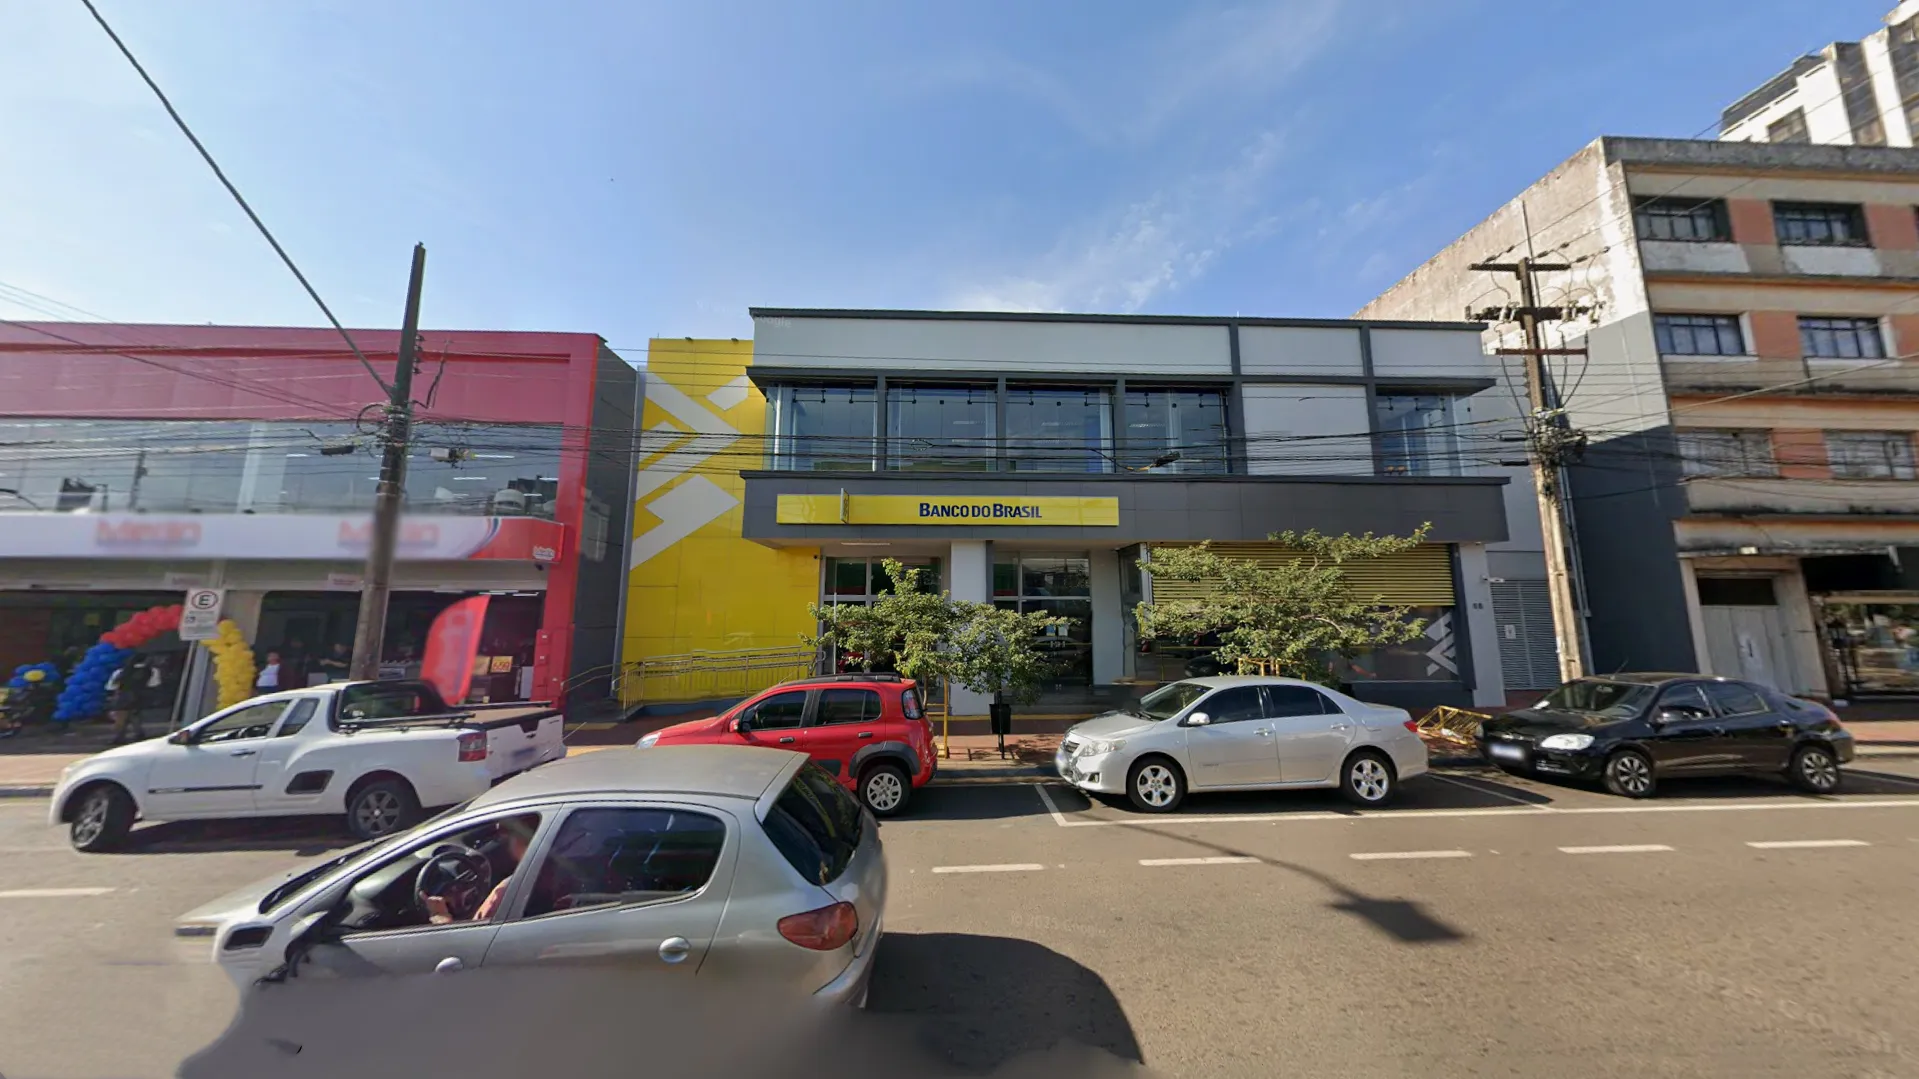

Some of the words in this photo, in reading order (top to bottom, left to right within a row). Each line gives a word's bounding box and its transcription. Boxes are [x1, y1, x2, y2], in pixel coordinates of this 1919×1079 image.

[919, 503, 969, 518] BANCO
[971, 505, 991, 518] DO
[993, 503, 1043, 519] BRASIL
[199, 594, 212, 606] E
